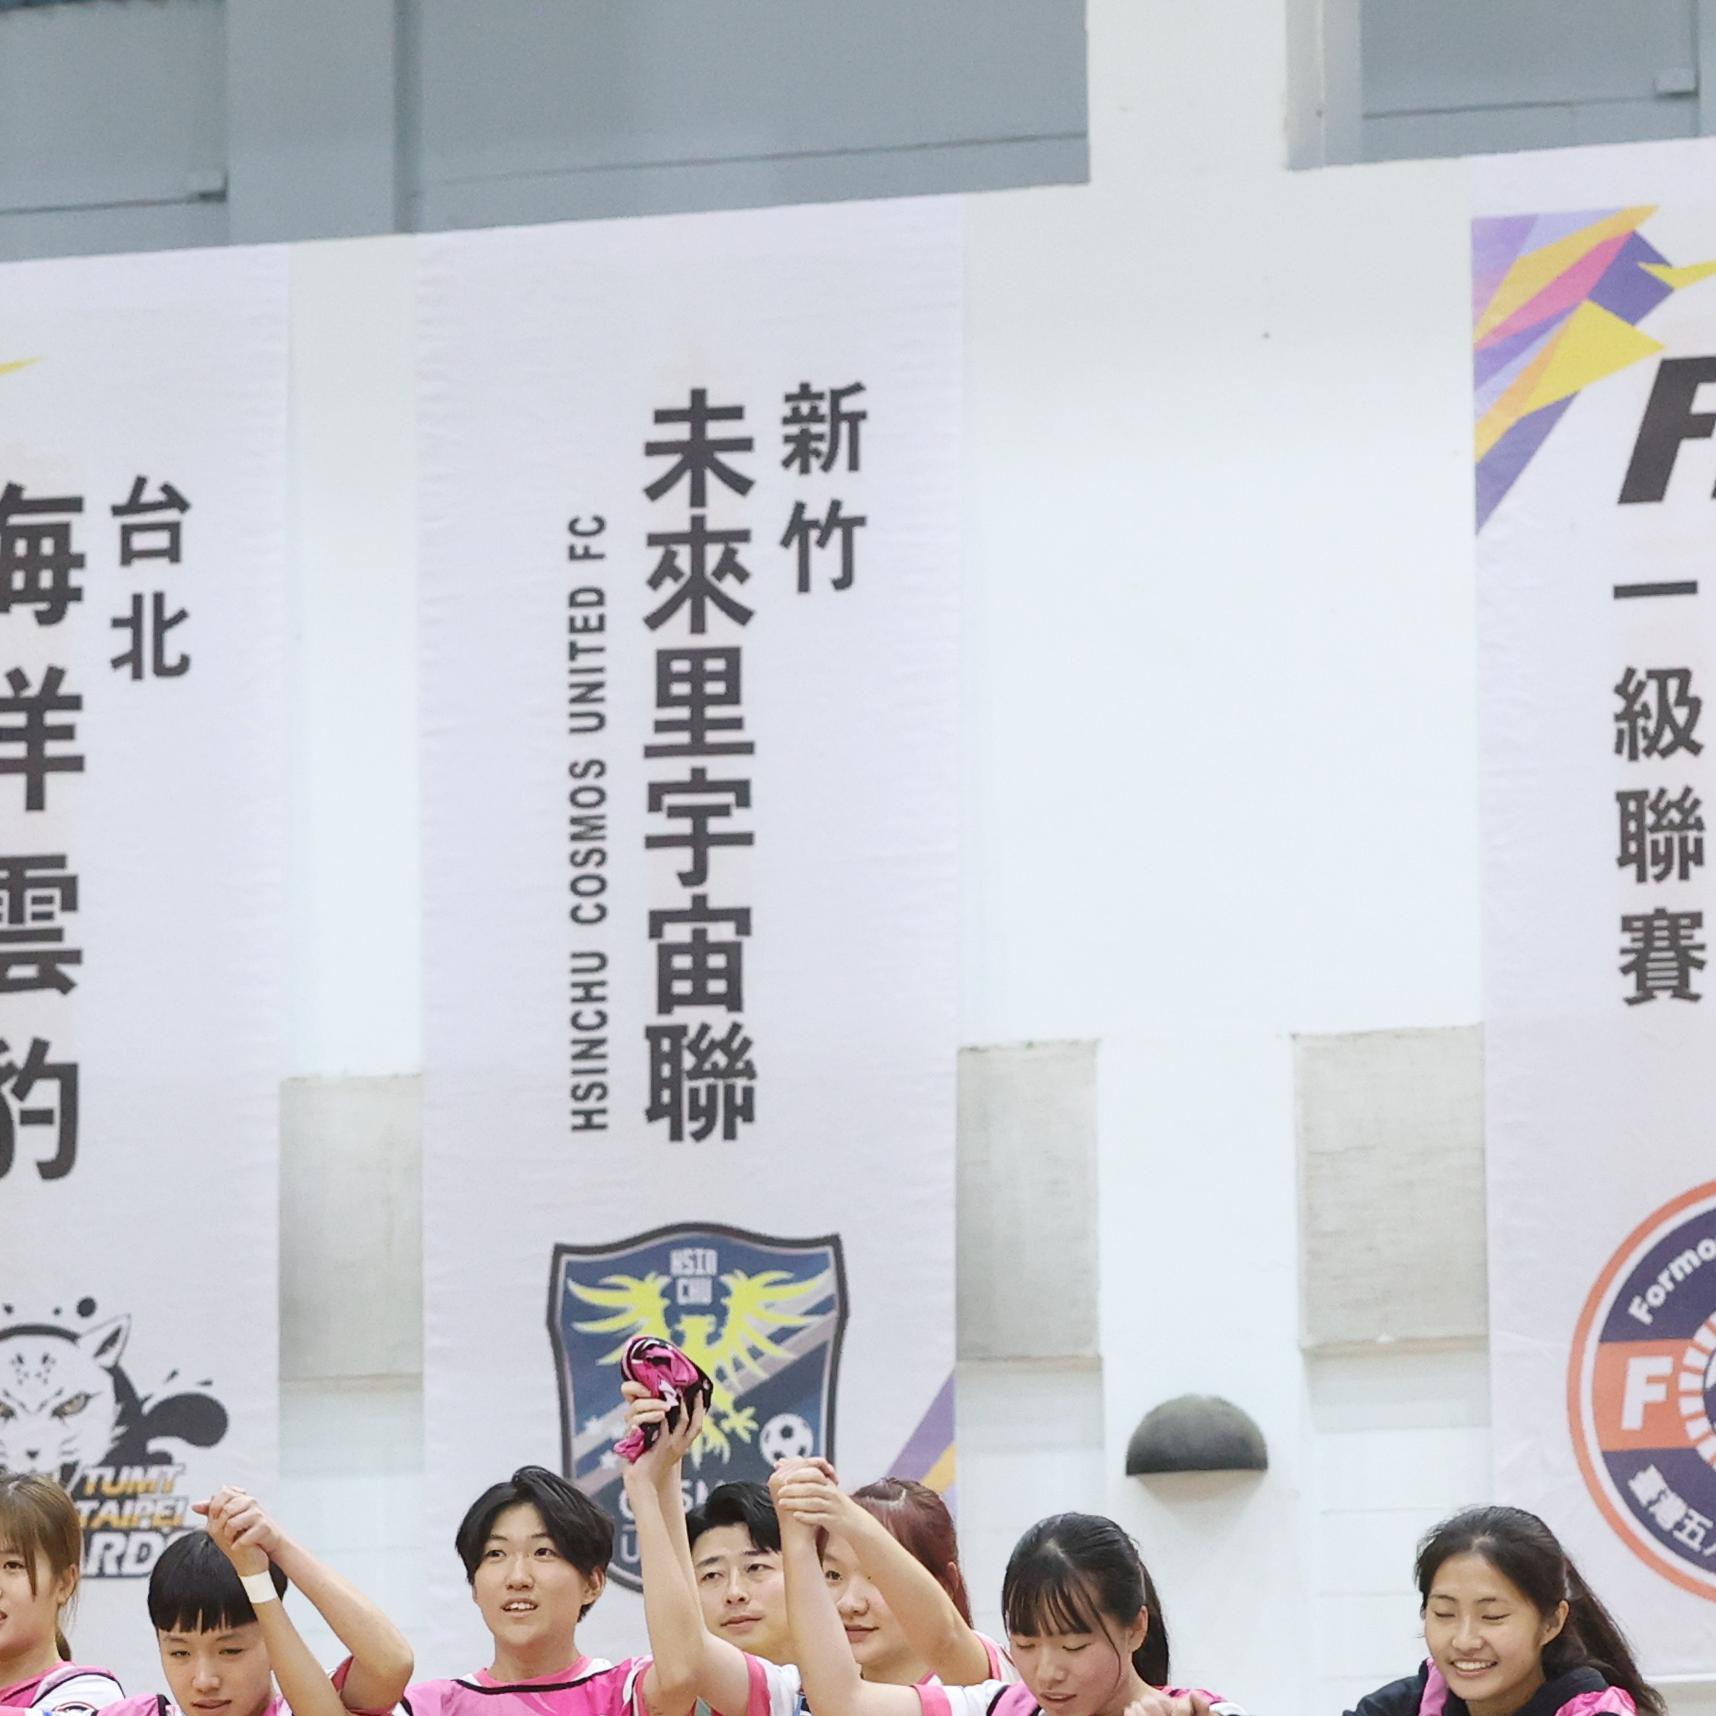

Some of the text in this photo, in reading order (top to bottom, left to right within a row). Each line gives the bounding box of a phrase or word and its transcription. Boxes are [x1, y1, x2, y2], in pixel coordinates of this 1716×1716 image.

[110, 475, 190, 680] 台北
[780, 382, 867, 593] 新竹
[568, 516, 608, 1131] HSINCHU COSMOS UNITED FC
[644, 388, 757, 1143] 未來里宇宙聯
[1613, 581, 1706, 1006] 一級聯賽
[1620, 1356, 1674, 1431] F
